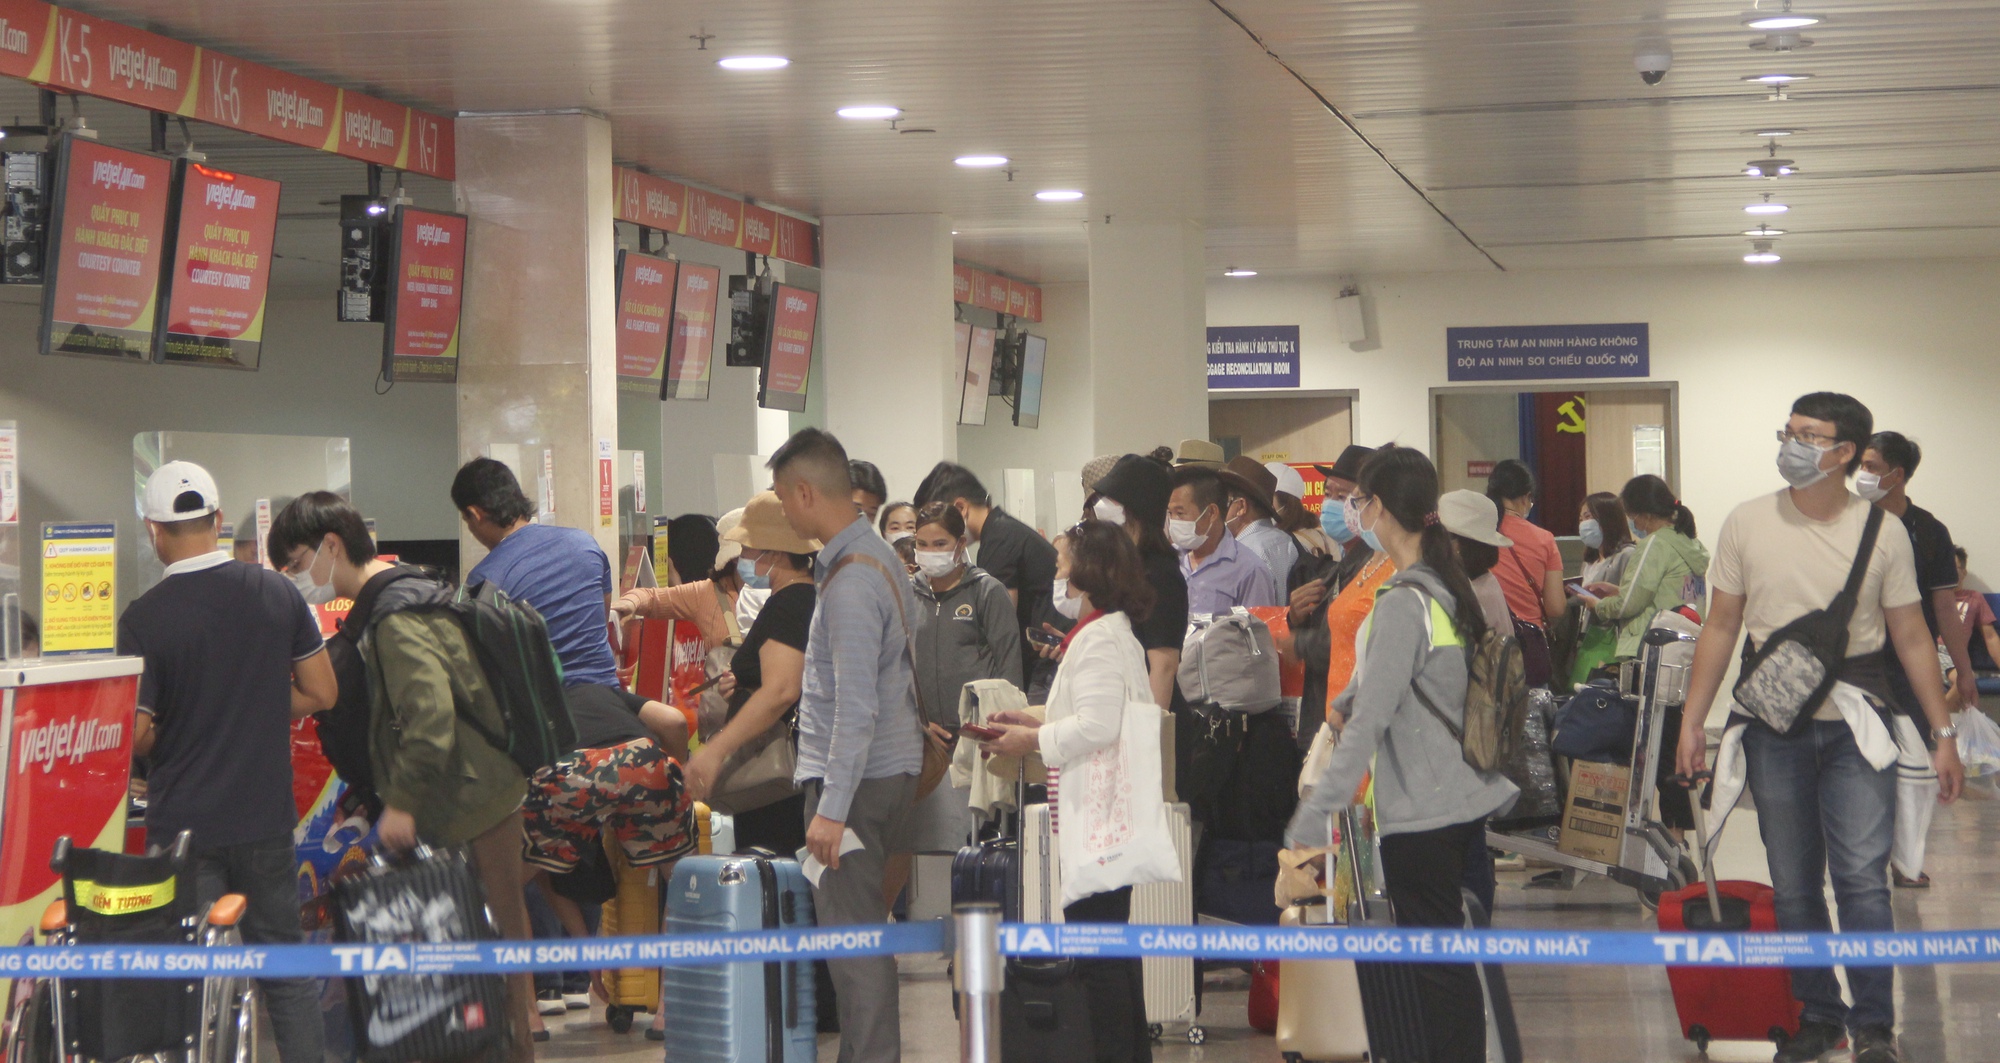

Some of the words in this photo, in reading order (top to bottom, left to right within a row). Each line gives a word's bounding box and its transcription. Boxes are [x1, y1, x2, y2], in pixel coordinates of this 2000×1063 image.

[59, 15, 92, 88] K-5
[212, 58, 241, 125] K-6
[418, 116, 438, 173] K-7
[624, 174, 640, 220] K-9
[688, 191, 708, 237] K-10
[78, 252, 111, 271] COURTESY
[111, 257, 141, 276] COUNTER
[191, 268, 223, 286] COURTESY
[223, 272, 251, 290] COUNTER
[1225, 341, 1235, 354] TRA
[1235, 339, 1250, 354] HÀNH
[1279, 341, 1289, 357] TỤC
[1290, 341, 1295, 353] K
[1457, 339, 1493, 349] TRUNG
[1496, 337, 1519, 348] TÂM
[1521, 338, 1536, 348] AN
[1539, 338, 1564, 348] NINH
[1567, 336, 1597, 347] HÀNG
[1600, 335, 1638, 347] KHÔNG
[1226, 362, 1272, 375] RECONCILIATION
[1273, 362, 1290, 375] ROOM
[1457, 356, 1476, 369] ĐỘI
[1479, 357, 1494, 366] AN
[1498, 357, 1523, 366] NINH
[1527, 356, 1545, 366] SOI
[1549, 354, 1581, 365] CHIẾU
[1585, 353, 1616, 365] QUỐC
[1620, 354, 1639, 367] NỘI
[998, 927, 1053, 952] IA
[1061, 936, 1128, 945] INTERNATIONAL
[1062, 926, 1079, 935] TAN
[1081, 926, 1099, 935] SON
[1744, 935, 1763, 944] TAN
[1764, 935, 1783, 944] SON
[1785, 935, 1809, 944] NHAT
[417, 943, 433, 952] TAN
[436, 943, 453, 952] SON
[493, 946, 531, 964] TAN
[536, 945, 577, 963] SON
[582, 943, 633, 961] NHAT
[639, 937, 793, 959] INTERNATIONAL
[797, 930, 883, 952] AIRPORT
[1062, 946, 1099, 954] AIRPORT
[1139, 928, 1197, 950] CẢNG
[1203, 930, 1260, 951] HÀNG
[1266, 931, 1338, 952] KHÔNG
[1344, 931, 1402, 954] QUỐC
[1408, 931, 1434, 954] TẾ
[1440, 932, 1479, 954] TÂN
[1485, 936, 1529, 955] SƠN
[1535, 934, 1590, 956] NHẤT
[1653, 936, 1735, 962] TIA
[1744, 946, 1814, 955] INTERNATIONAL
[1826, 939, 1867, 957] TAN
[1873, 939, 1917, 957] SON
[1923, 937, 1978, 956] NHAT
[26, 950, 84, 972] QUỐC
[89, 950, 115, 971] TẾ
[119, 951, 159, 971] TÂN
[164, 952, 207, 971] SƠN
[213, 948, 266, 970] NHẤT
[331, 946, 408, 971] TIA
[416, 953, 482, 962] INTERNATIONAL
[417, 963, 453, 971] AIRPORT
[1744, 956, 1784, 965] AIRPORT
